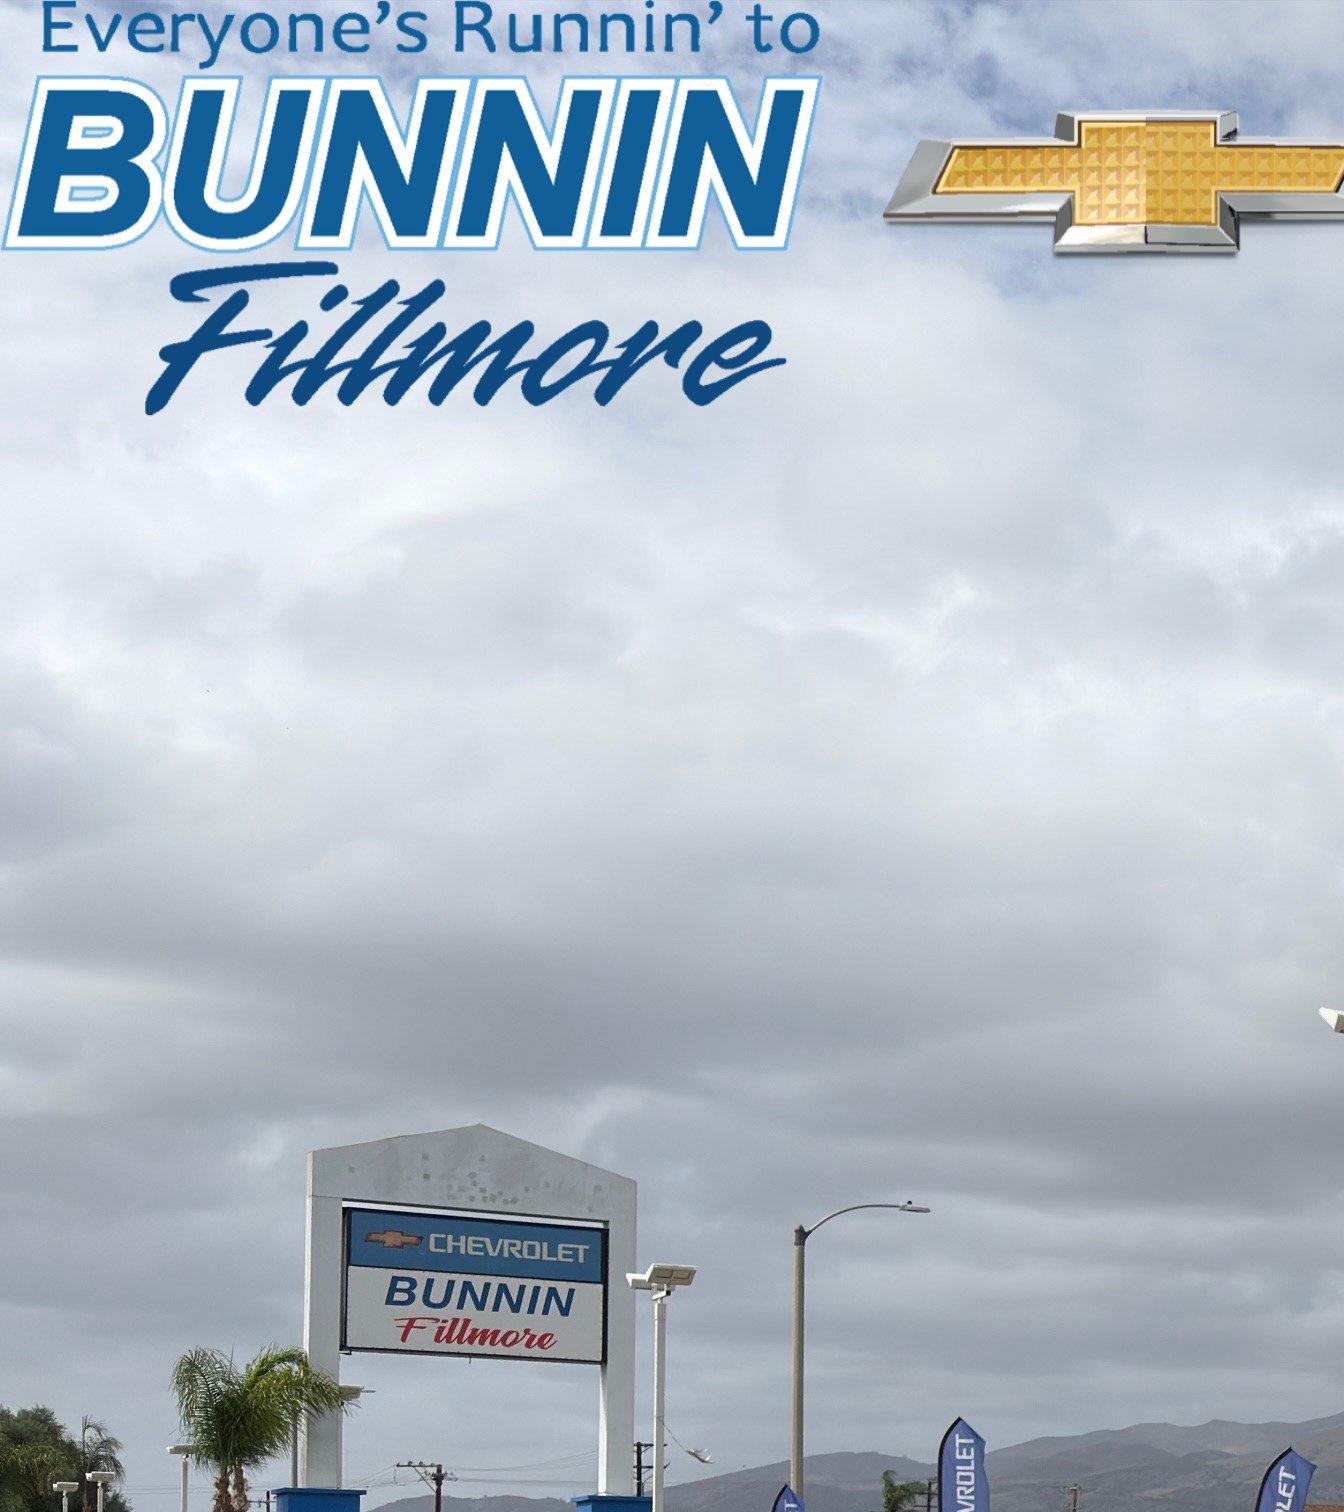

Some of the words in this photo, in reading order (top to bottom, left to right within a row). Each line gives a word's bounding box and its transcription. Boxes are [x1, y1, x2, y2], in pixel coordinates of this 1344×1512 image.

[429, 1233, 590, 1264] CHEVROLET
[384, 1275, 576, 1317] BUNNIN
[394, 1316, 558, 1350] Fillmore
